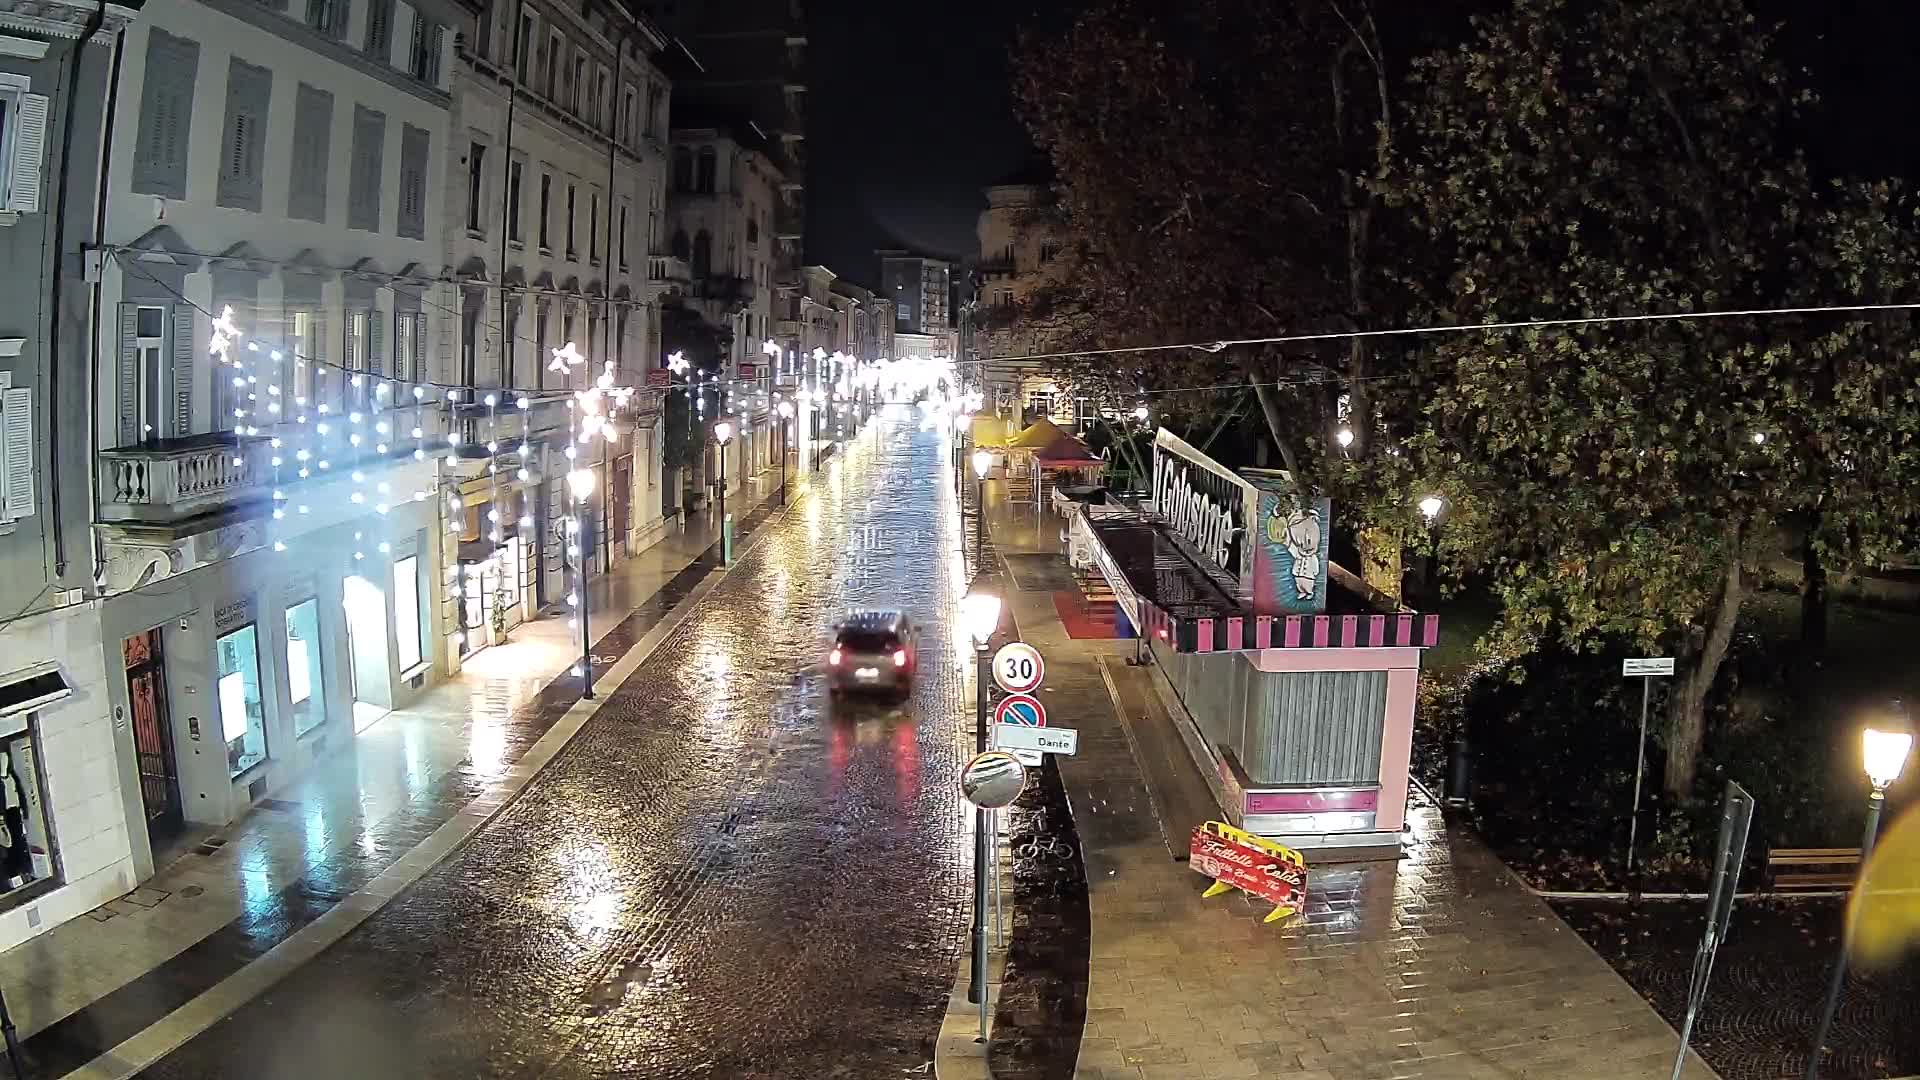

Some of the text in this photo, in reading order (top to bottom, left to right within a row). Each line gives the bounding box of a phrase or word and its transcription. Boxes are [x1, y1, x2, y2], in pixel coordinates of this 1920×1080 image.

[1162, 457, 1233, 570] Golosone
[1006, 658, 1032, 679] 30
[1038, 737, 1070, 749] Dante
